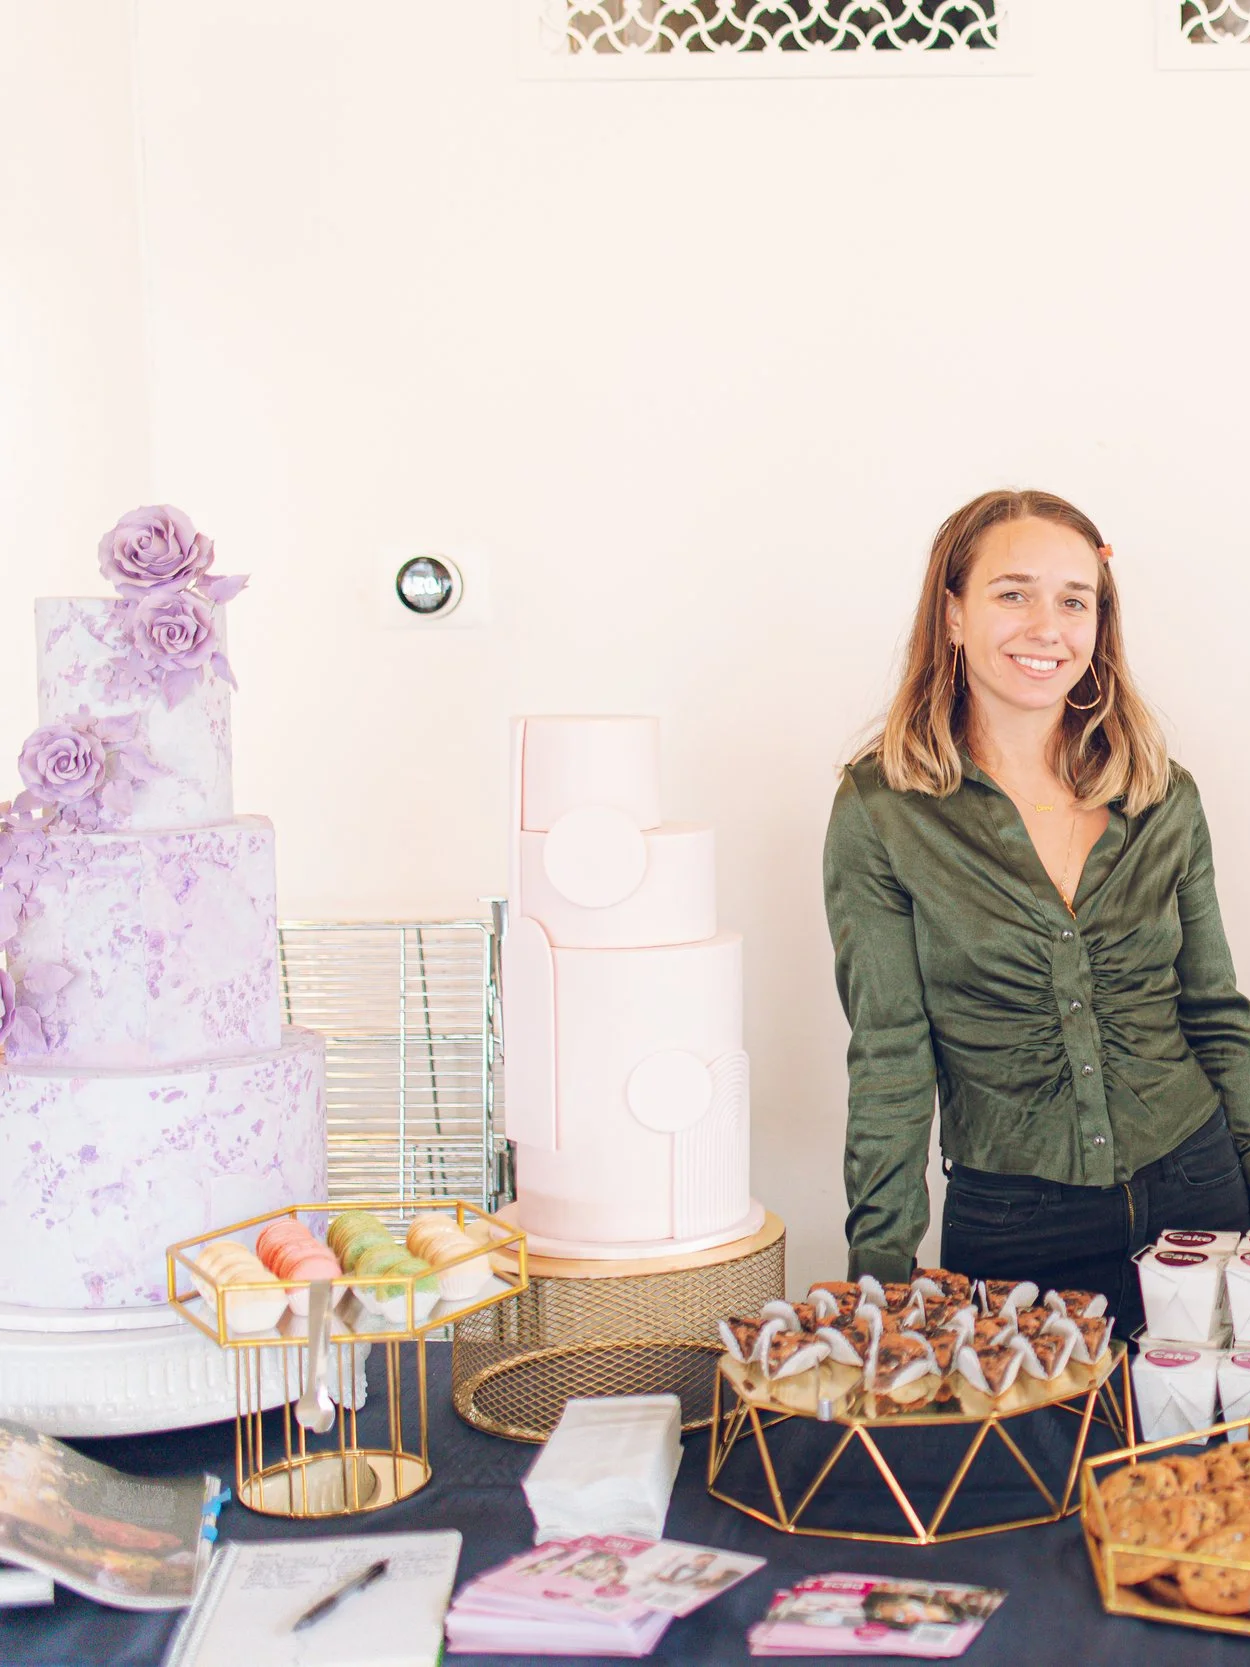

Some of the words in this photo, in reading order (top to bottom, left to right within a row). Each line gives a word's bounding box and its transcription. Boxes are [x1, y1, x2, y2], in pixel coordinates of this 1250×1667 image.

[1168, 1233, 1213, 1242] Cake
[1158, 1252, 1204, 1262] Cake
[1150, 1351, 1195, 1361] Cake
